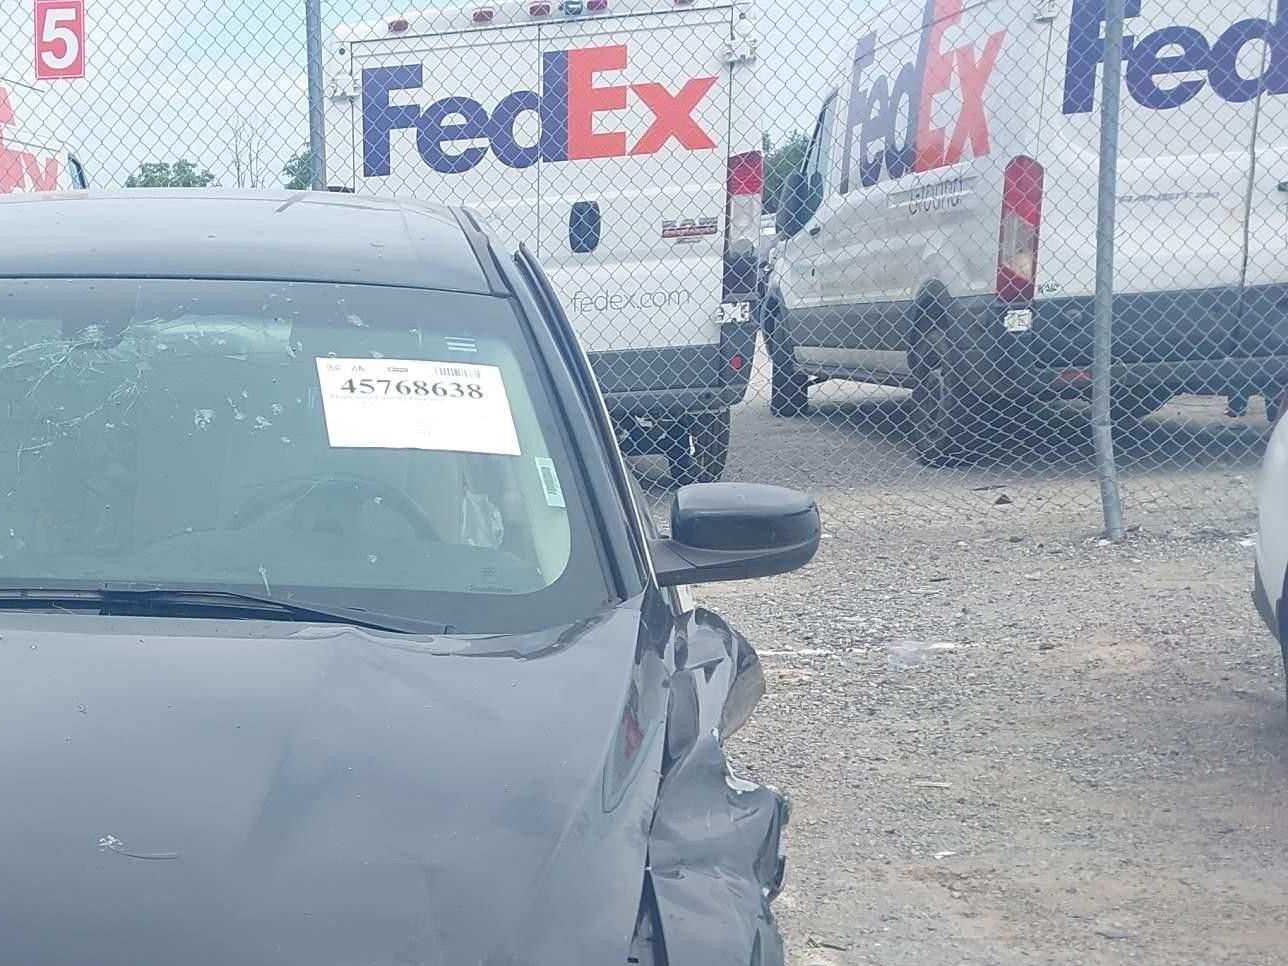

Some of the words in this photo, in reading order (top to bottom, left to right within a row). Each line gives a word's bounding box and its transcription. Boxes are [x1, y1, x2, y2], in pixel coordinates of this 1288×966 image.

[41, 8, 79, 69] 5
[362, 44, 719, 177] FedEx
[839, 0, 1008, 194] FedEx
[572, 289, 690, 313] fedex.com
[341, 378, 484, 400] 45768638
